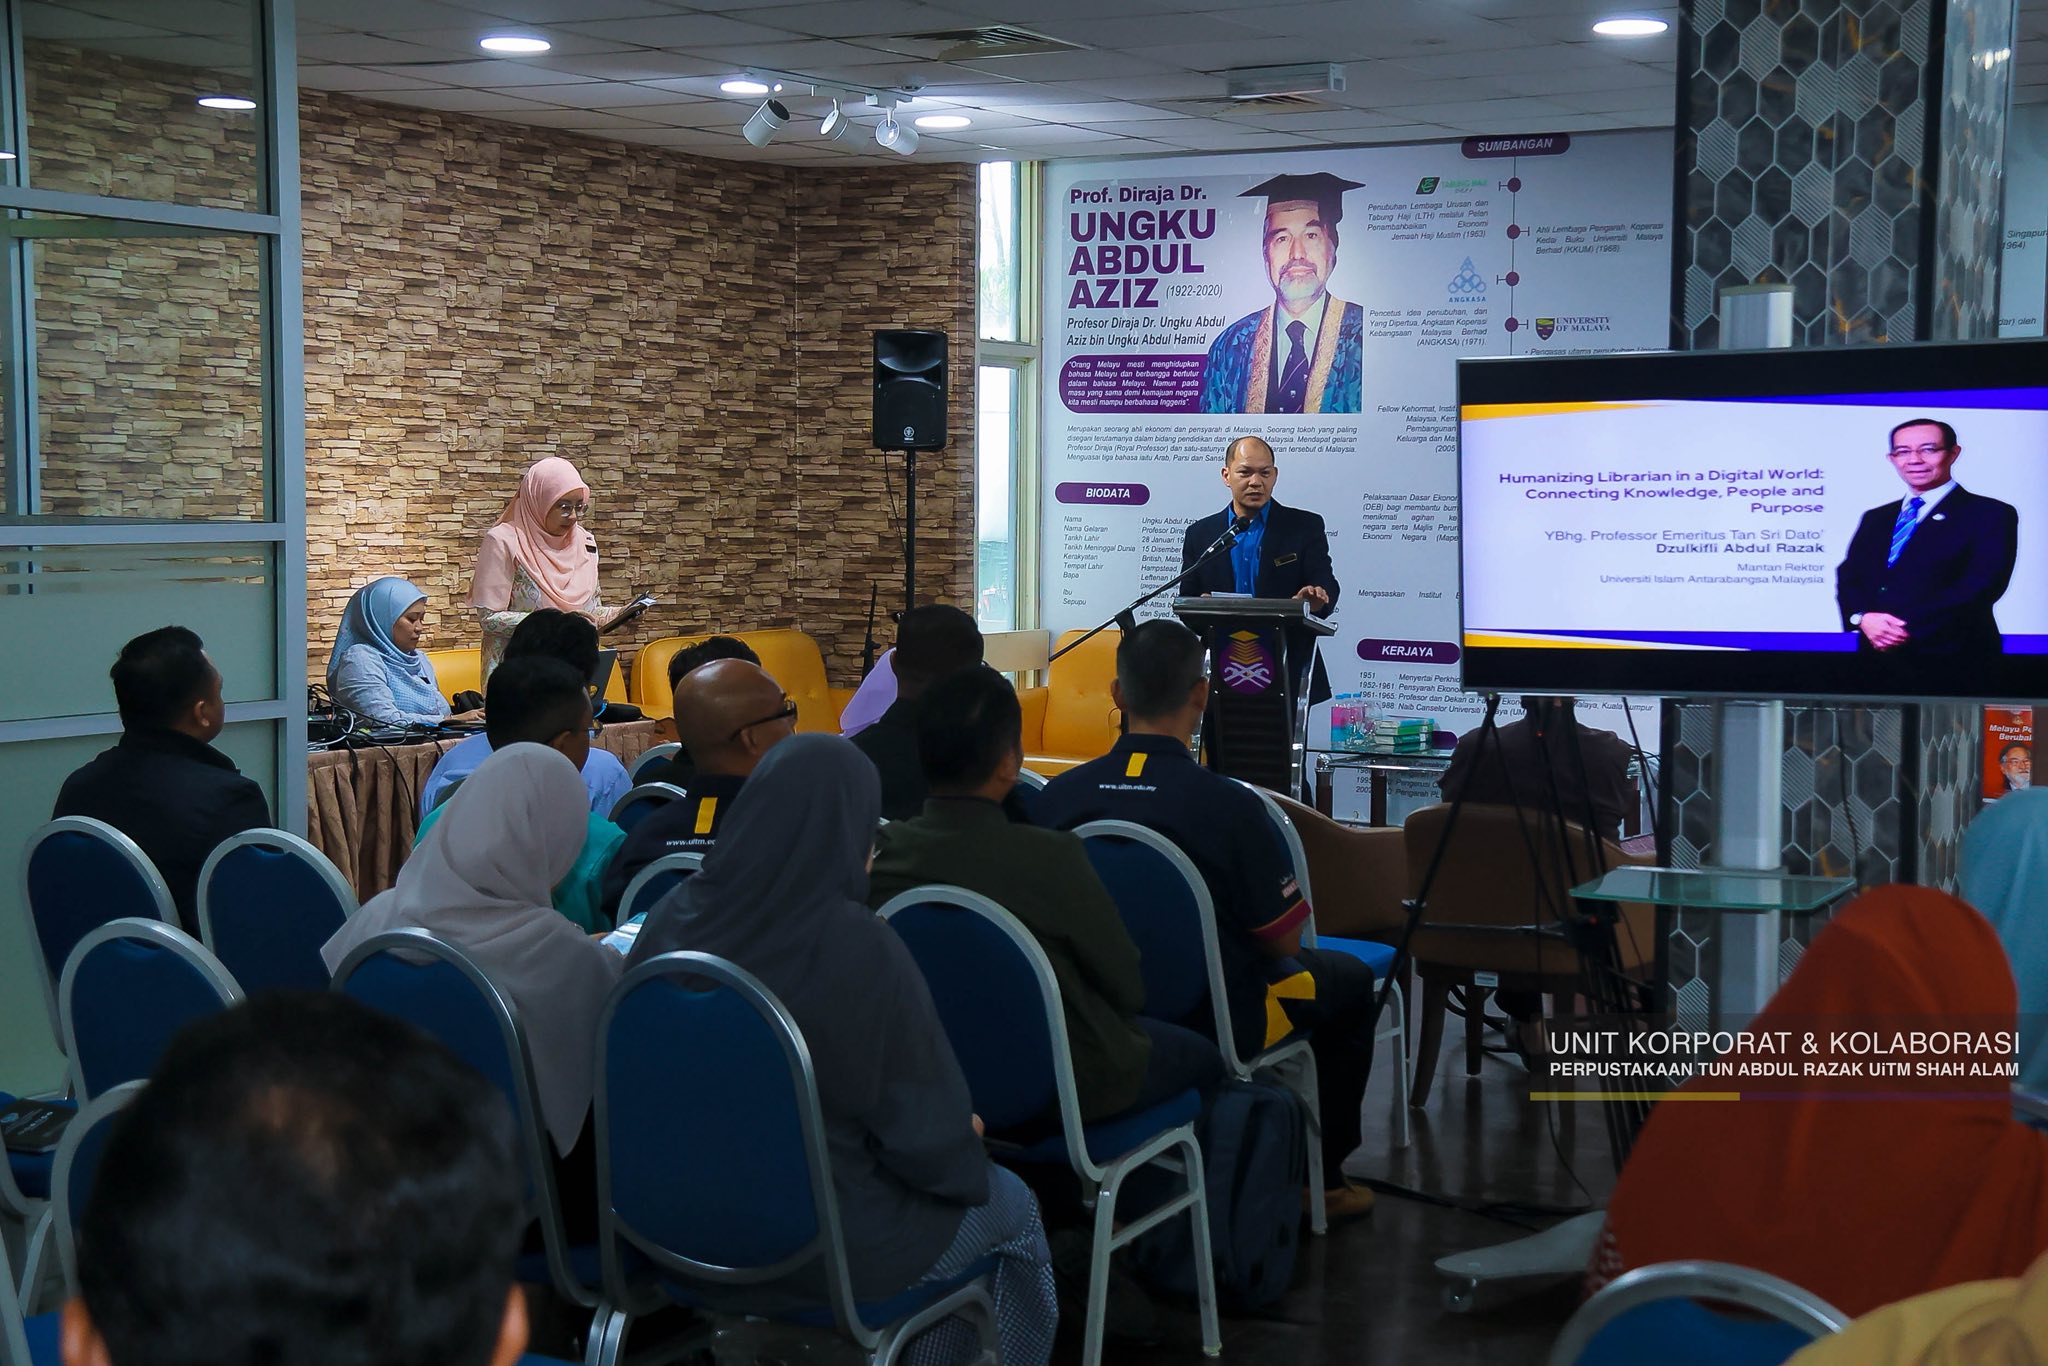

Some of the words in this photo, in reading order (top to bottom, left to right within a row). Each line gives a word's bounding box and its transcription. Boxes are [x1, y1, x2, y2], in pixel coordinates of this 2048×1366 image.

[1477, 138, 1553, 152] SUMBANGAN
[1070, 188, 1113, 204] Prof.
[1120, 186, 1174, 205] Diraja
[1180, 185, 1207, 201] Dr.
[1069, 208, 1217, 242] UNGKU
[1068, 243, 1205, 276] ABDUL
[1068, 278, 1159, 309] AZIZ
[1166, 284, 1223, 300] (1922-2020)
[1067, 317, 1108, 329] Profesor
[1111, 317, 1140, 331] Diraja
[1143, 317, 1157, 328] Dr.
[1160, 317, 1193, 330] Ungku
[1196, 316, 1226, 327] Abdul
[1067, 334, 1087, 346] Aziz
[1089, 334, 1105, 345] bin
[1107, 334, 1139, 348] Ungku
[1142, 333, 1171, 345] Abdul
[1174, 333, 1206, 345] Hamid
[1499, 472, 1594, 485] Humanizing
[1598, 471, 1671, 482] Librarian
[1676, 470, 1690, 481] in
[1695, 472, 1704, 481] a
[1708, 470, 1763, 483] Digital
[1768, 469, 1824, 479] World:
[1086, 488, 1130, 498] BIODATA
[1526, 488, 1619, 501] Connecting
[1624, 487, 1723, 500] Knowledge,
[1726, 486, 1787, 499] People
[1792, 486, 1824, 496] and
[1751, 503, 1824, 515] Purpose
[1545, 531, 1587, 543] YBhg.
[1591, 530, 1658, 541] Professor
[1663, 530, 1726, 540] Emeritus
[1730, 530, 1756, 540] Tan
[1760, 530, 1780, 540] Sri
[1785, 529, 1824, 540] Dato'
[1656, 544, 1718, 553] Dzulkifli
[1724, 544, 1770, 553] Abdul
[1776, 544, 1825, 553] Razak
[1785, 563, 1824, 571] Rektor
[1600, 575, 1651, 583] Universiti
[1654, 575, 1685, 583] Islam
[1688, 575, 1769, 585] Antarabangsa
[1772, 575, 1824, 585] Malaysia
[1382, 645, 1434, 657] KERJAYA
[1399, 674, 1433, 682] Menyertai
[1602, 702, 1623, 710] Kuala
